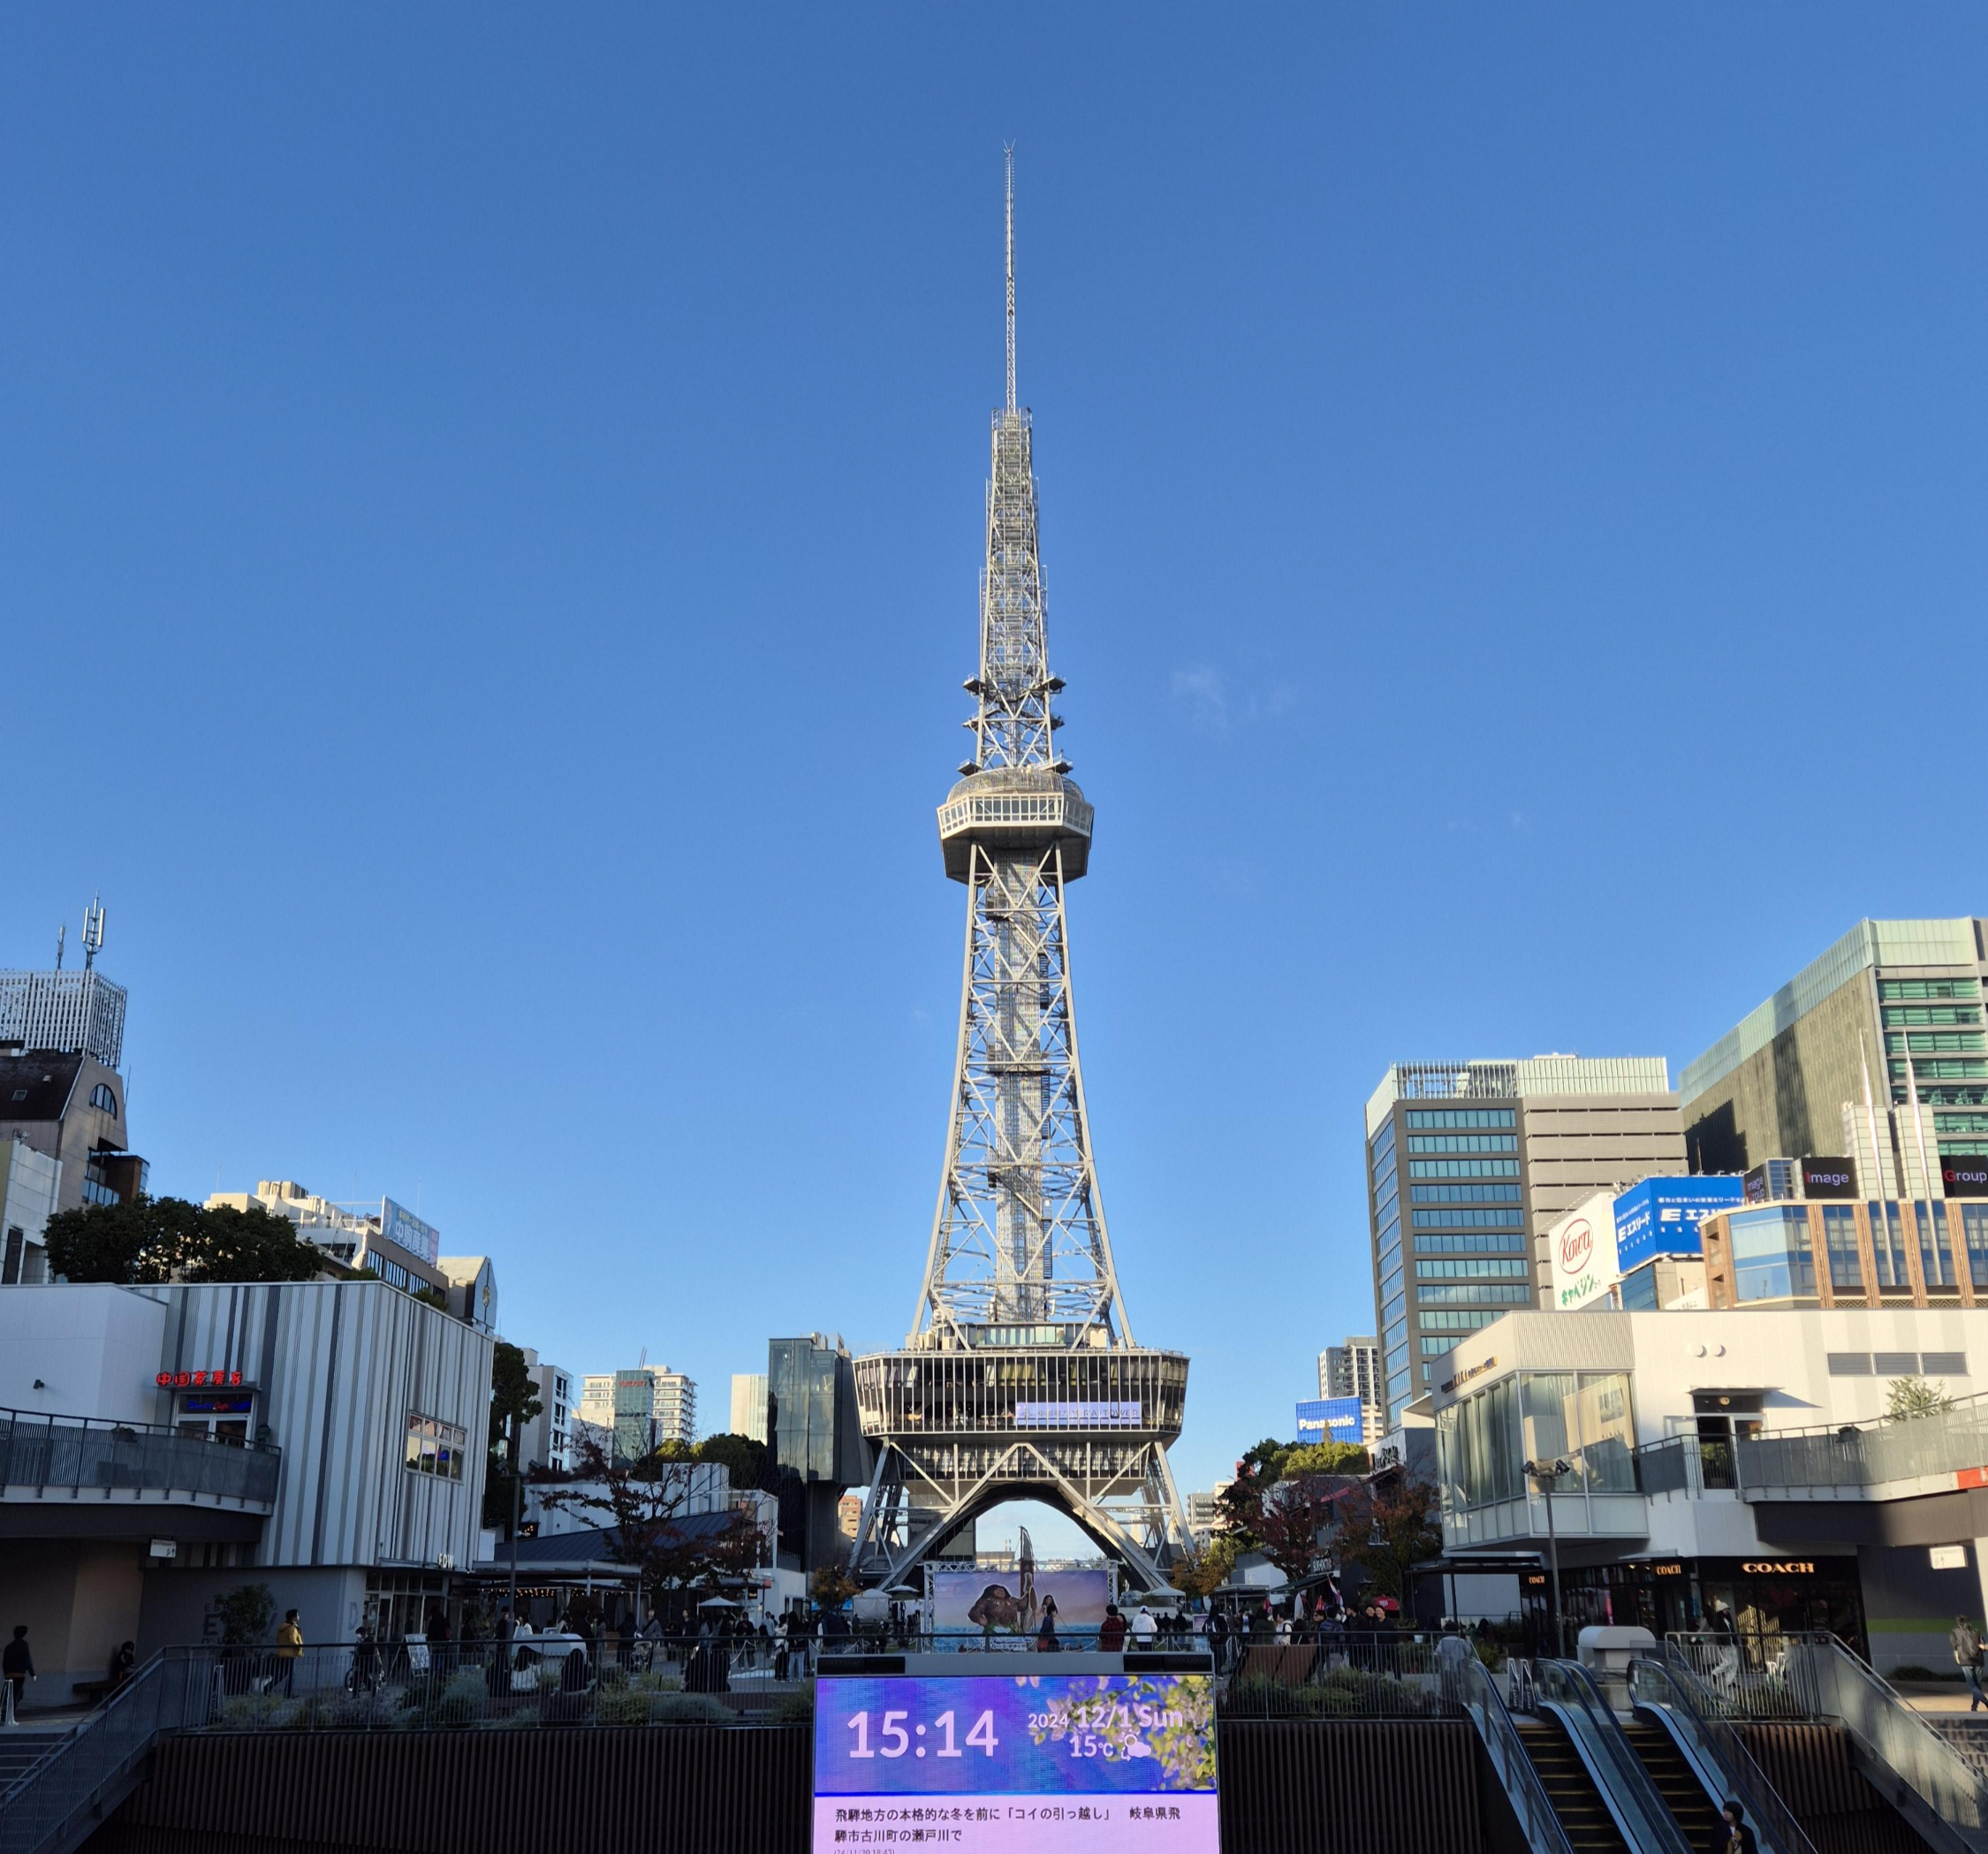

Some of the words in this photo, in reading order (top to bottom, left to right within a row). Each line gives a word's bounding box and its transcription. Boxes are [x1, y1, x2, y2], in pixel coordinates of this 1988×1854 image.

[1805, 1172, 1849, 1186] Image
[1945, 1170, 1988, 1184] Group
[1562, 1228, 1591, 1266] Kowa
[1103, 1409, 1140, 1417] TOWER
[1656, 1564, 1682, 1576] COACH
[1741, 1562, 1815, 1573] COACH
[1529, 1576, 1545, 1584] COACH
[1028, 1713, 1070, 1729] 2024
[1076, 1706, 1133, 1729] 12/1
[1139, 1706, 1183, 1729] Sun
[846, 1709, 999, 1759] 15:14
[1129, 1805, 1181, 1821] 岐阜県飛
